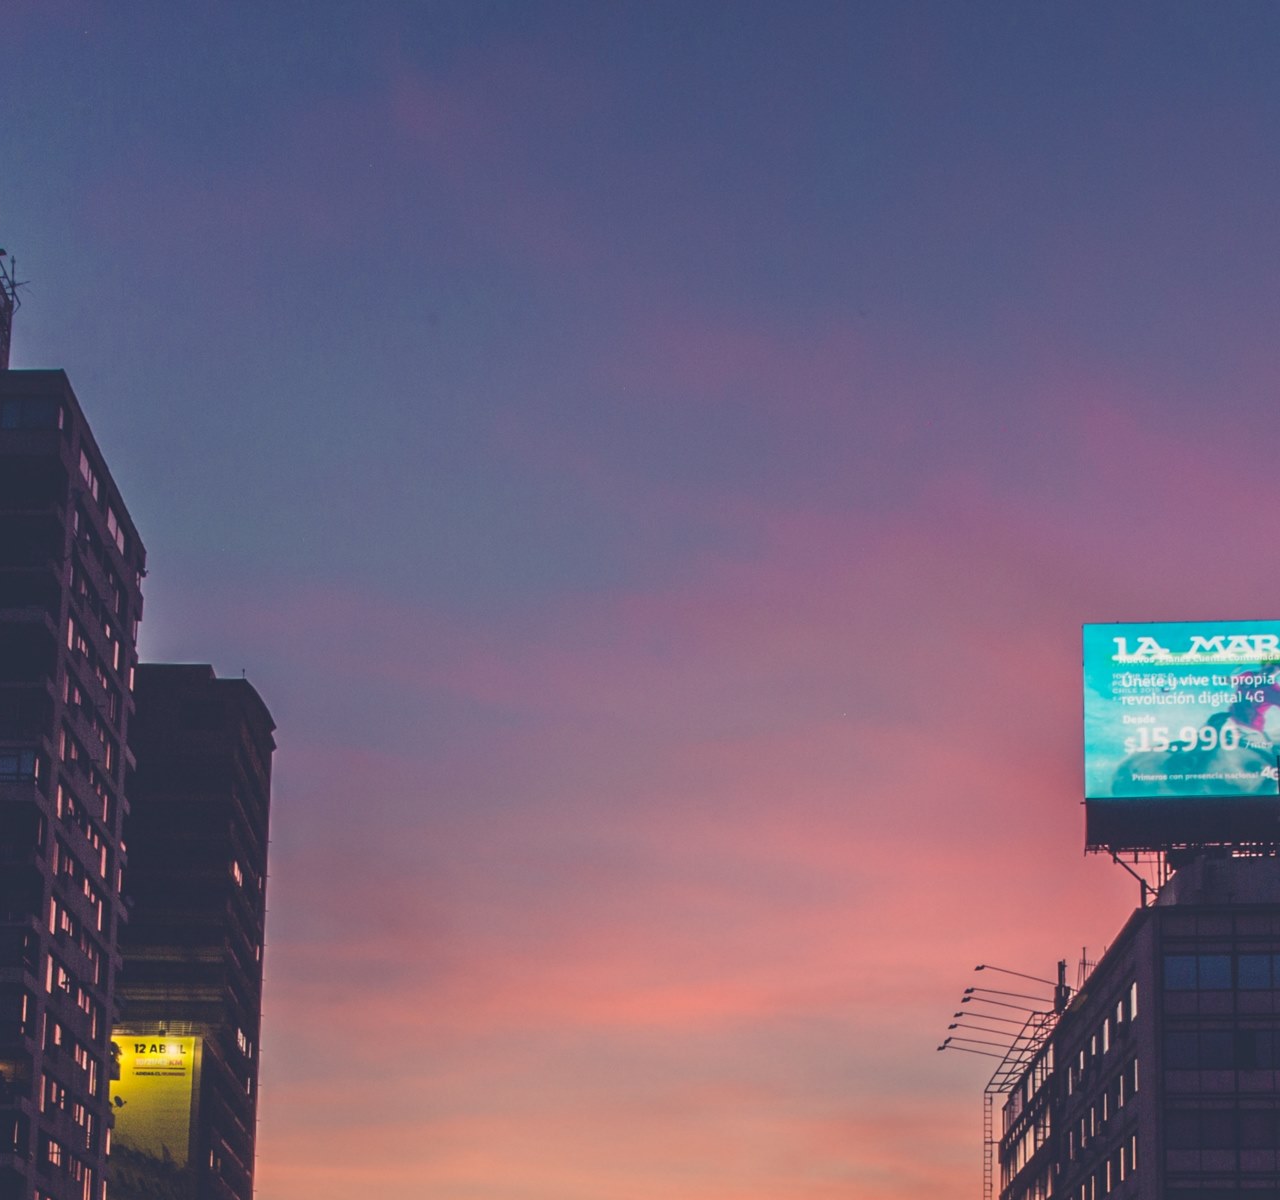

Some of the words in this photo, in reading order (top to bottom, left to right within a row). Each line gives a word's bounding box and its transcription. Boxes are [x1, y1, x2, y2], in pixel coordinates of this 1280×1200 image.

[1168, 676, 1177, 690] y
[1180, 674, 1210, 686] vive
[1212, 675, 1229, 687] tu
[1230, 673, 1276, 690] propia
[1122, 690, 1196, 706] revolución
[1198, 690, 1242, 706] digital
[1245, 690, 1265, 703] 4G
[1123, 714, 1156, 724] Desde
[1124, 726, 1240, 752] $15.990
[1132, 773, 1168, 782] Primeros
[1185, 772, 1223, 782] presencia
[1225, 771, 1259, 780] nacional
[134, 1043, 147, 1054] 12
